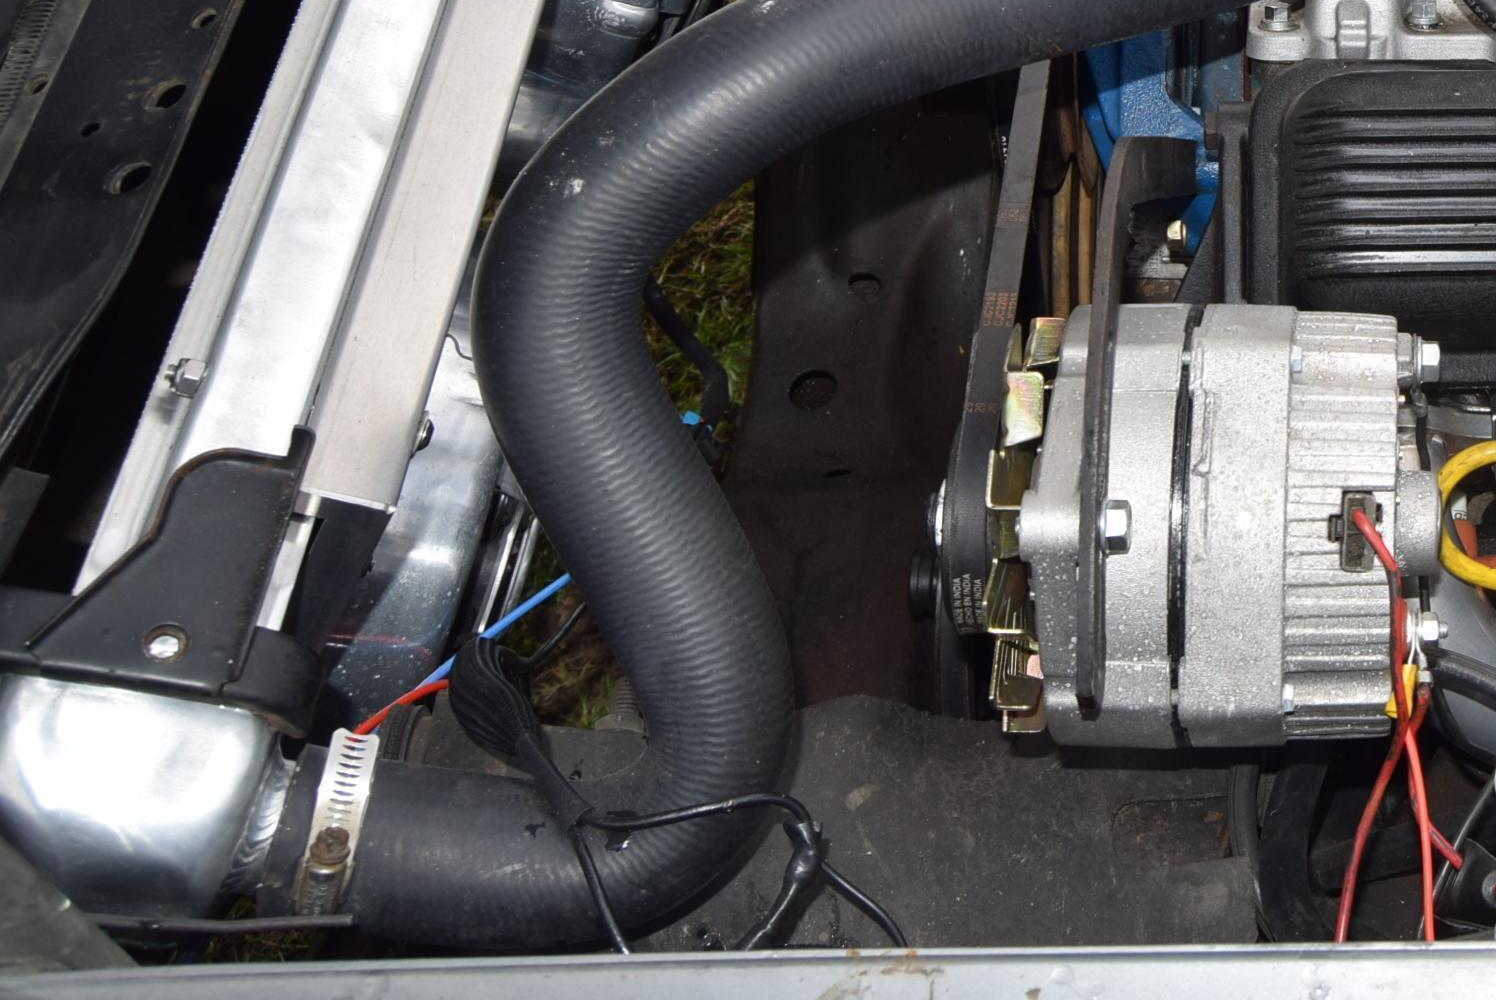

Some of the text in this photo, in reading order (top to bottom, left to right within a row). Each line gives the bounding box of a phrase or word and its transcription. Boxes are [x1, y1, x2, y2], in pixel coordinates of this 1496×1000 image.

[952, 577, 963, 599] INDIA
[962, 573, 972, 595] INDIA
[973, 578, 983, 600] INDIA
[954, 608, 964, 624] MADE
